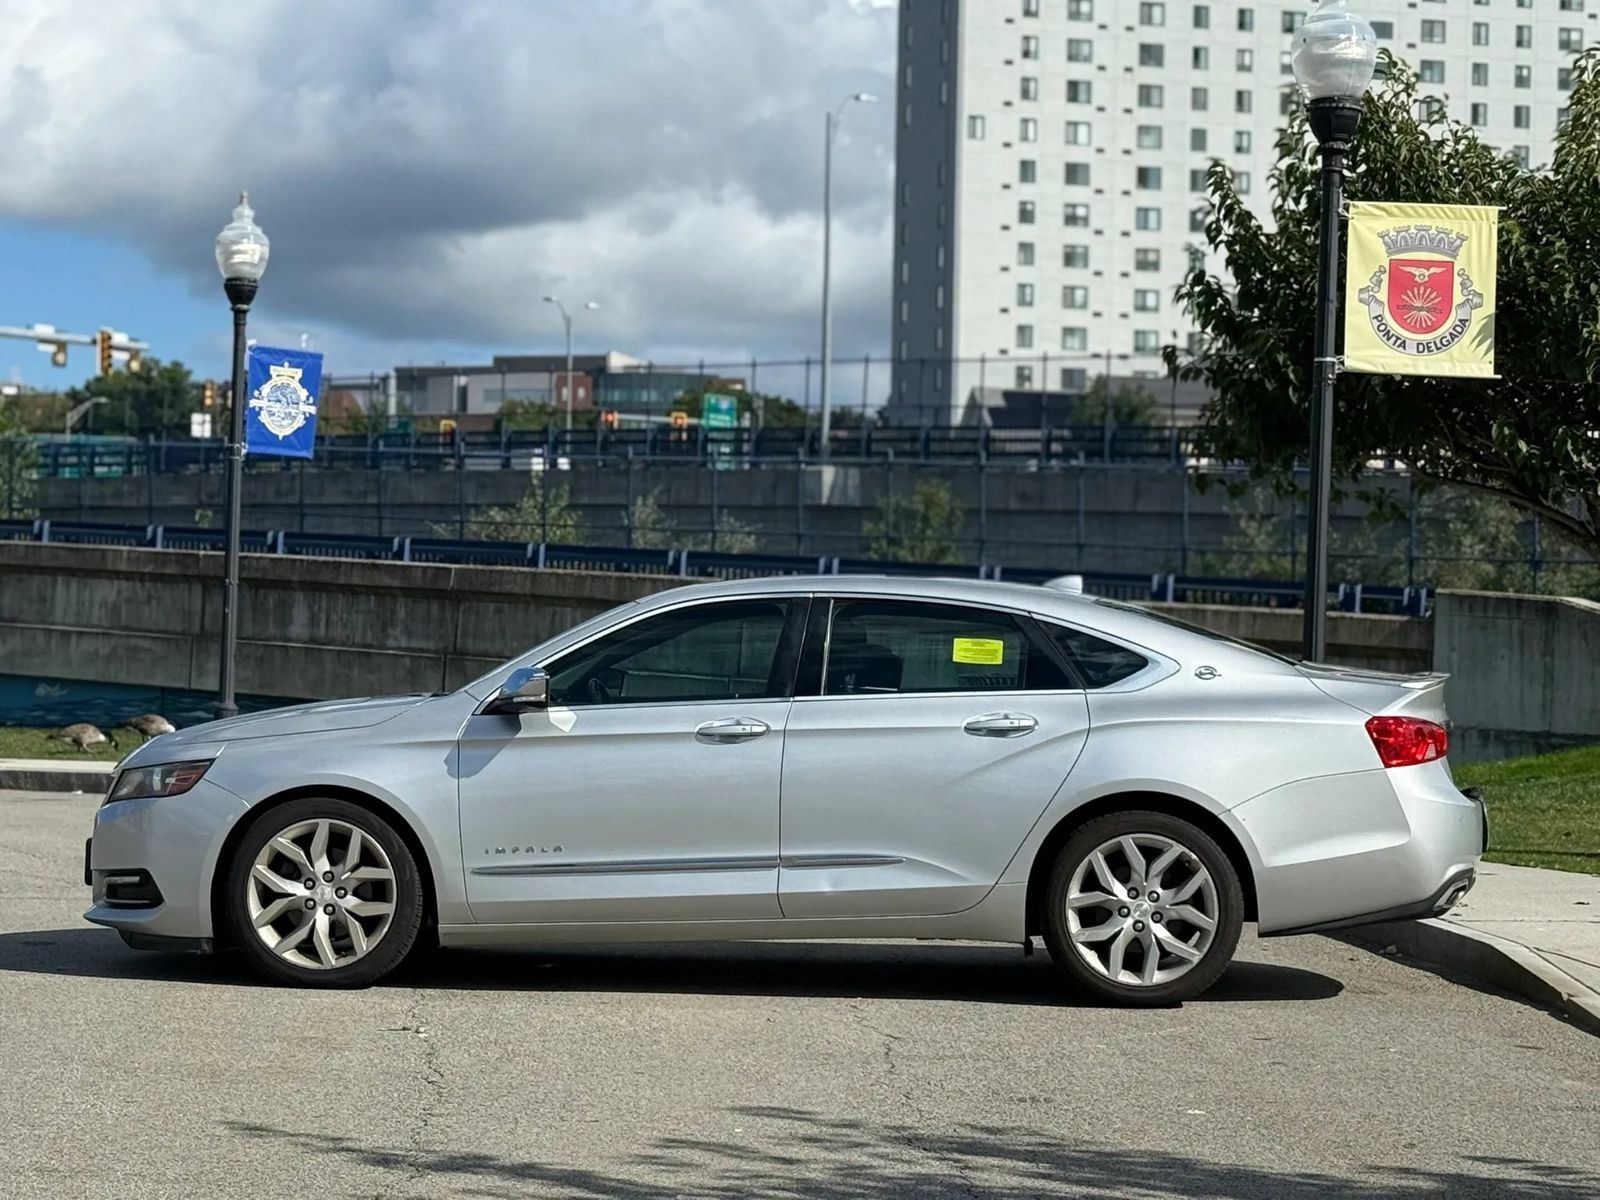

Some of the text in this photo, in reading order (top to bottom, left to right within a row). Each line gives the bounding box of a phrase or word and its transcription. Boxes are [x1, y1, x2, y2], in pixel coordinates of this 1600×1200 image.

[1372, 314, 1469, 354] PONTA DELGADA
[484, 845, 563, 855] IMPALA
